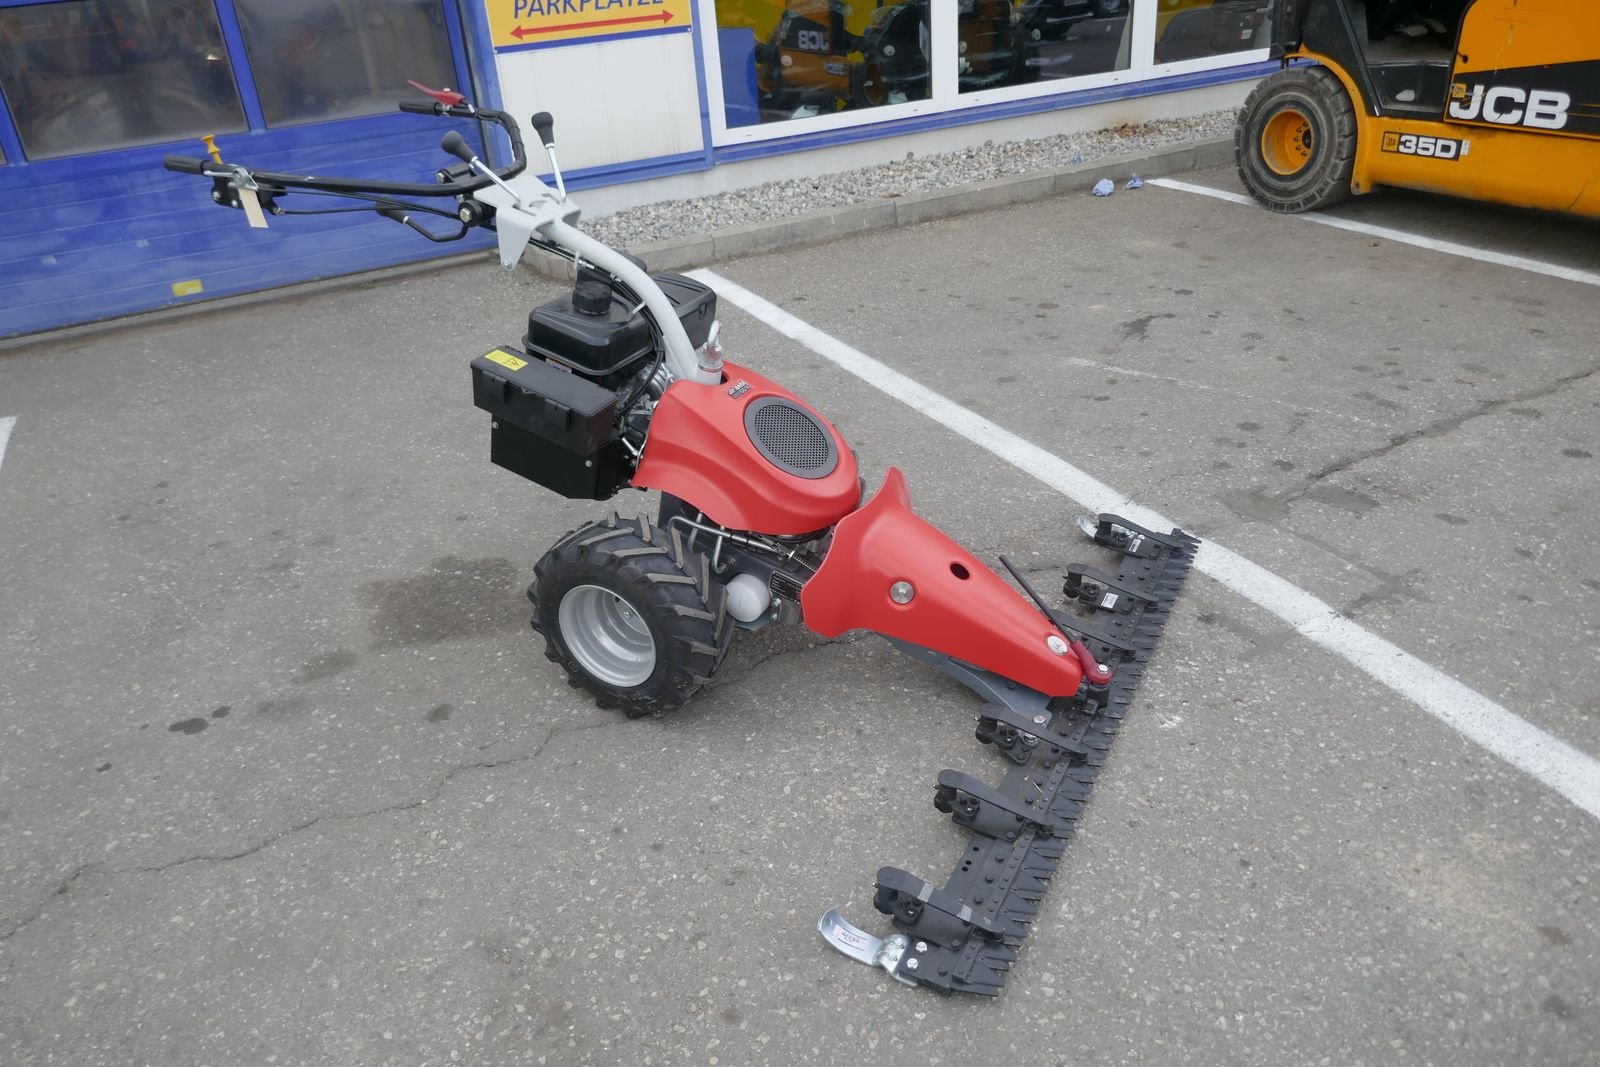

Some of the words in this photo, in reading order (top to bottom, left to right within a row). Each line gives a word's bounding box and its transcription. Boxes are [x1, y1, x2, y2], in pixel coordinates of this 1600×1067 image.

[514, 0, 664, 19] PARKPL
[1449, 84, 1571, 129] JCB
[1399, 134, 1457, 159] 35D
